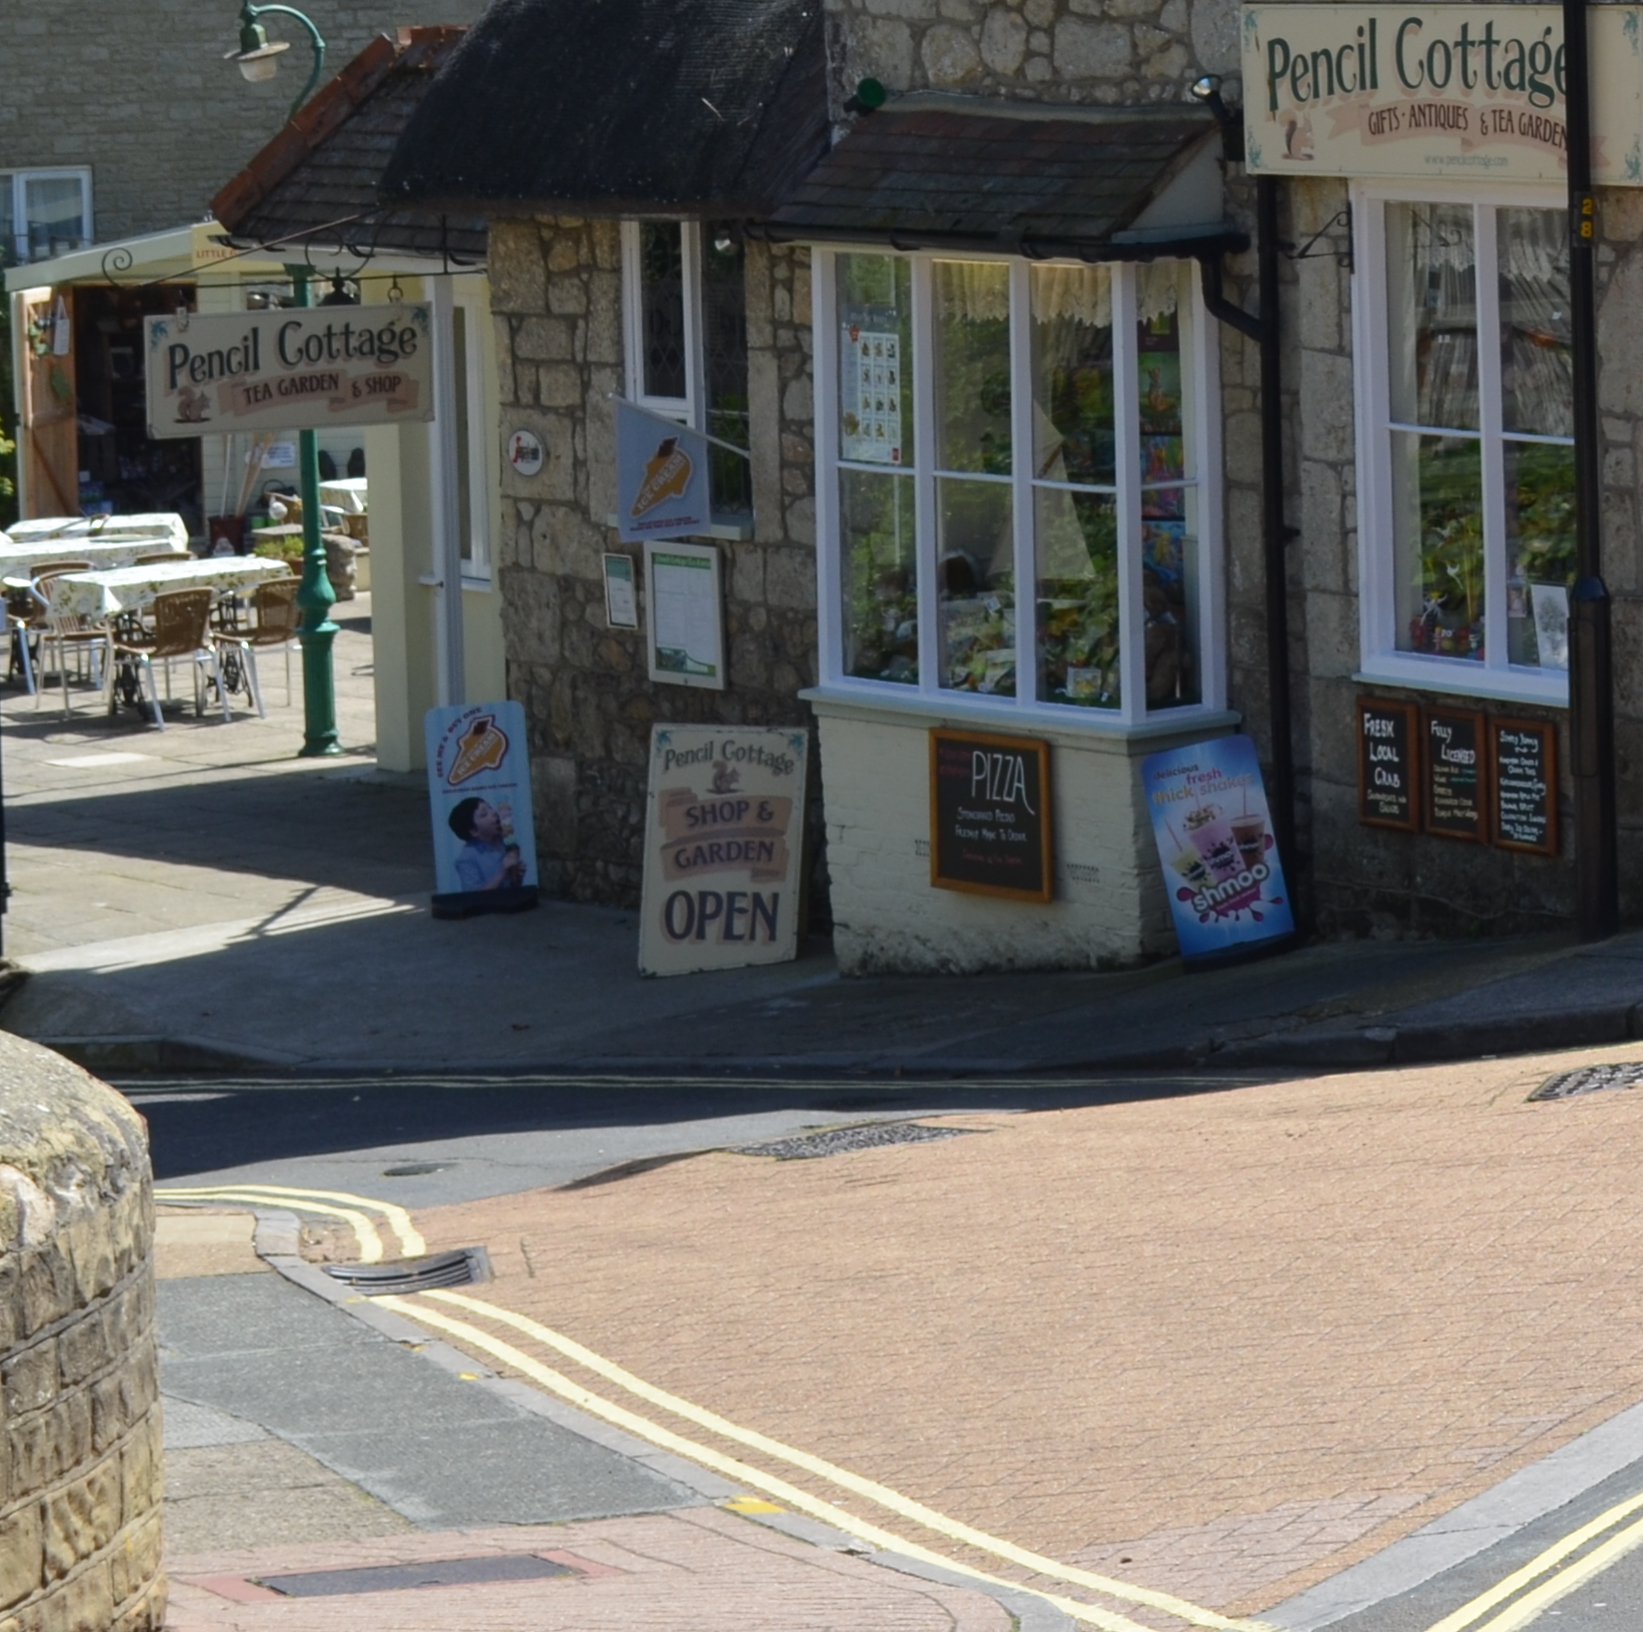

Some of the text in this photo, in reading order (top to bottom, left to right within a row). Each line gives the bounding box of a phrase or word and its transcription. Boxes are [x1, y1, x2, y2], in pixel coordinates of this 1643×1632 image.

[1267, 18, 1378, 112] Pencil
[1368, 106, 1400, 135] GIFTS
[1409, 103, 1468, 131] ANTIQUES
[1480, 115, 1488, 136] &
[1491, 109, 1514, 133] TEA
[168, 321, 417, 389] Pencil Cottage
[243, 373, 401, 405] TEA GARDEN & SHOP
[1363, 712, 1395, 738] FRESH
[665, 739, 794, 774] Pencil Cottage
[1369, 741, 1400, 763] LOCAL
[971, 750, 1035, 815] PIZZA
[1153, 764, 1199, 781] delicious
[1186, 768, 1222, 785] fresh
[1374, 766, 1401, 788] CRAB
[1152, 774, 1255, 805] thick shakes
[686, 799, 775, 827] SHOP &
[674, 841, 775, 869] GARDEN
[1193, 864, 1269, 912] shmoo
[664, 889, 780, 942] OPEN
